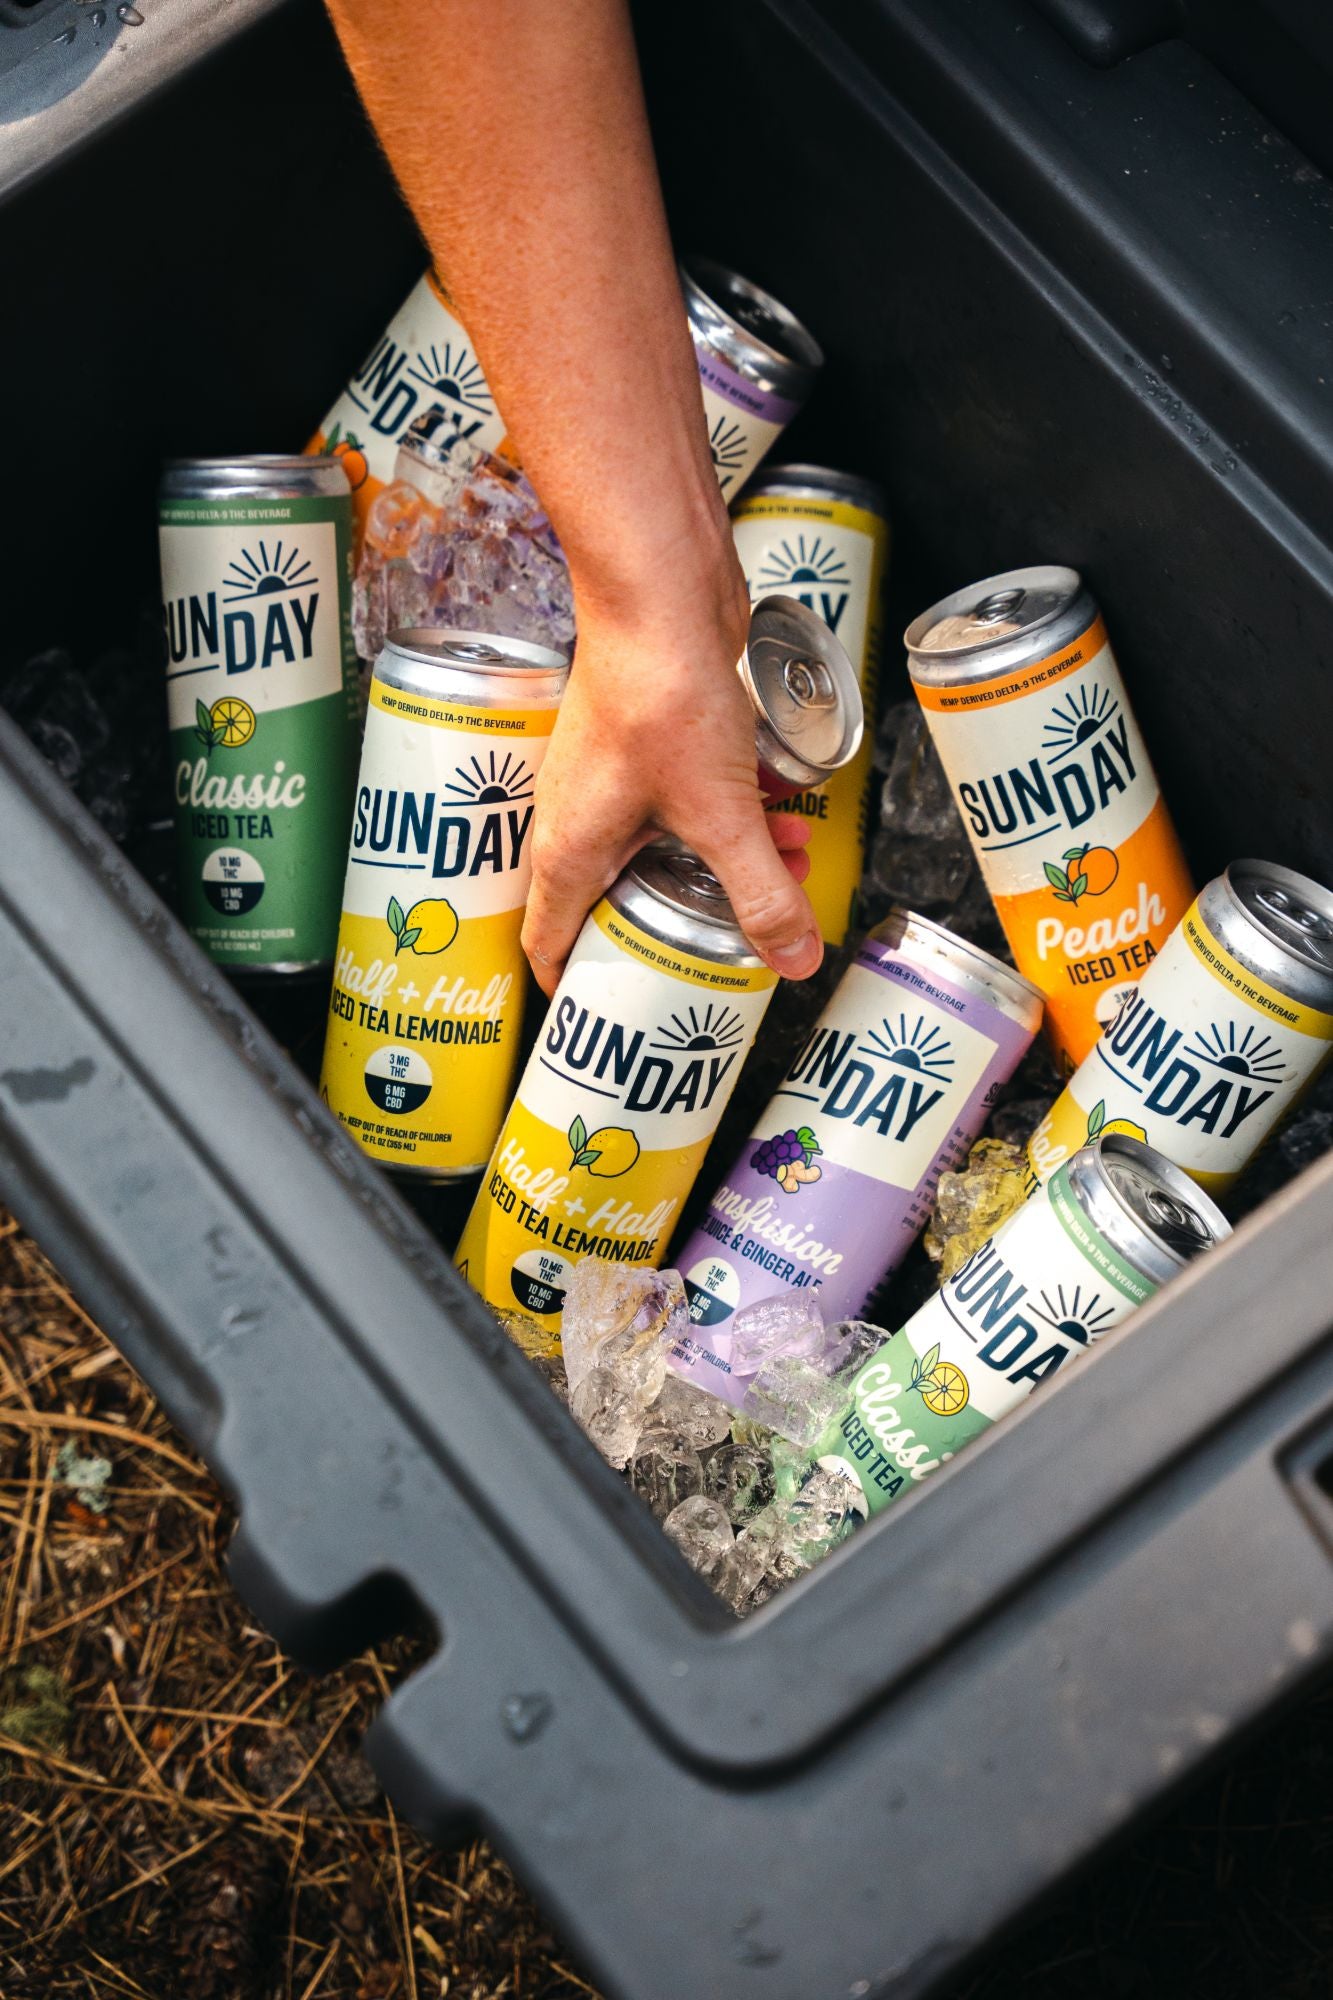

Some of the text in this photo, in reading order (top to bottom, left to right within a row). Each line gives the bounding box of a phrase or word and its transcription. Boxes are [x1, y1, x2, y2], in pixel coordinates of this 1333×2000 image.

[940, 650, 1083, 707] HEMP DERIVED DELTA-9 THC BEVERAGE
[381, 695, 526, 730] HEMP DERIVED DELTA-9 THC BEVERAGE
[175, 757, 306, 810] Classic
[959, 713, 1137, 838] SUNDAY
[191, 813, 274, 839] ICED TEA
[353, 786, 535, 879] SUNDAY
[219, 856, 241, 868] 10 MG
[223, 868, 238, 880] THC
[230, 887, 243, 899] MG
[1036, 882, 1166, 961] Peach
[607, 921, 751, 987] HEMP DERIVED DELTA-9 THC BEVERAGE
[1066, 939, 1158, 986] ICED TEA
[1186, 919, 1300, 1024] HEMP DERIVED DELTA-9 THC BEVERAGE
[334, 946, 513, 1021] Half + Half
[882, 960, 911, 981] DELTA-9
[910, 974, 926, 990] THC
[925, 984, 967, 1013] BEVERAGE
[330, 985, 504, 1045] ICED TEA LEMONADE
[389, 1053, 410, 1067] 3 MG
[390, 1065, 406, 1078] THC
[546, 995, 739, 1115] SUNDAY
[1104, 986, 1276, 1139] SUNDAY
[385, 1084, 406, 1098] 6 MG
[385, 1096, 402, 1109] CBD
[785, 1028, 945, 1143] UNDAY
[347, 1115, 363, 1128] KEEP
[362, 1120, 375, 1132] OUT
[376, 1124, 385, 1134] OF
[385, 1127, 408, 1139] REACH
[408, 1130, 418, 1140] OF
[419, 1131, 453, 1142] CHILDREN
[362, 1134, 417, 1152] 12 FL OZ (355 ML)
[498, 1137, 679, 1240] Half + Half
[488, 1170, 659, 1263] ICED TEA LEMONADE
[712, 1186, 844, 1276] ansfusion
[538, 1256, 564, 1275] 10 MG
[539, 1268, 556, 1283] THC
[708, 1265, 728, 1282] 3 MG
[730, 1233, 744, 1252] &
[741, 1239, 796, 1283] GINGER
[1092, 1249, 1110, 1268] THC
[1106, 1263, 1148, 1300] BEVERAGE
[527, 1295, 545, 1309] CBD
[528, 1283, 553, 1301] 10 MG
[692, 1292, 711, 1311] 6 MG
[704, 1276, 720, 1292] THC
[688, 1304, 704, 1320] CBD
[949, 1238, 1071, 1390] SUNDA
[702, 1350, 732, 1374] CHILDREN
[855, 1362, 954, 1481] Classi
[839, 1410, 905, 1498] ICED TEA
